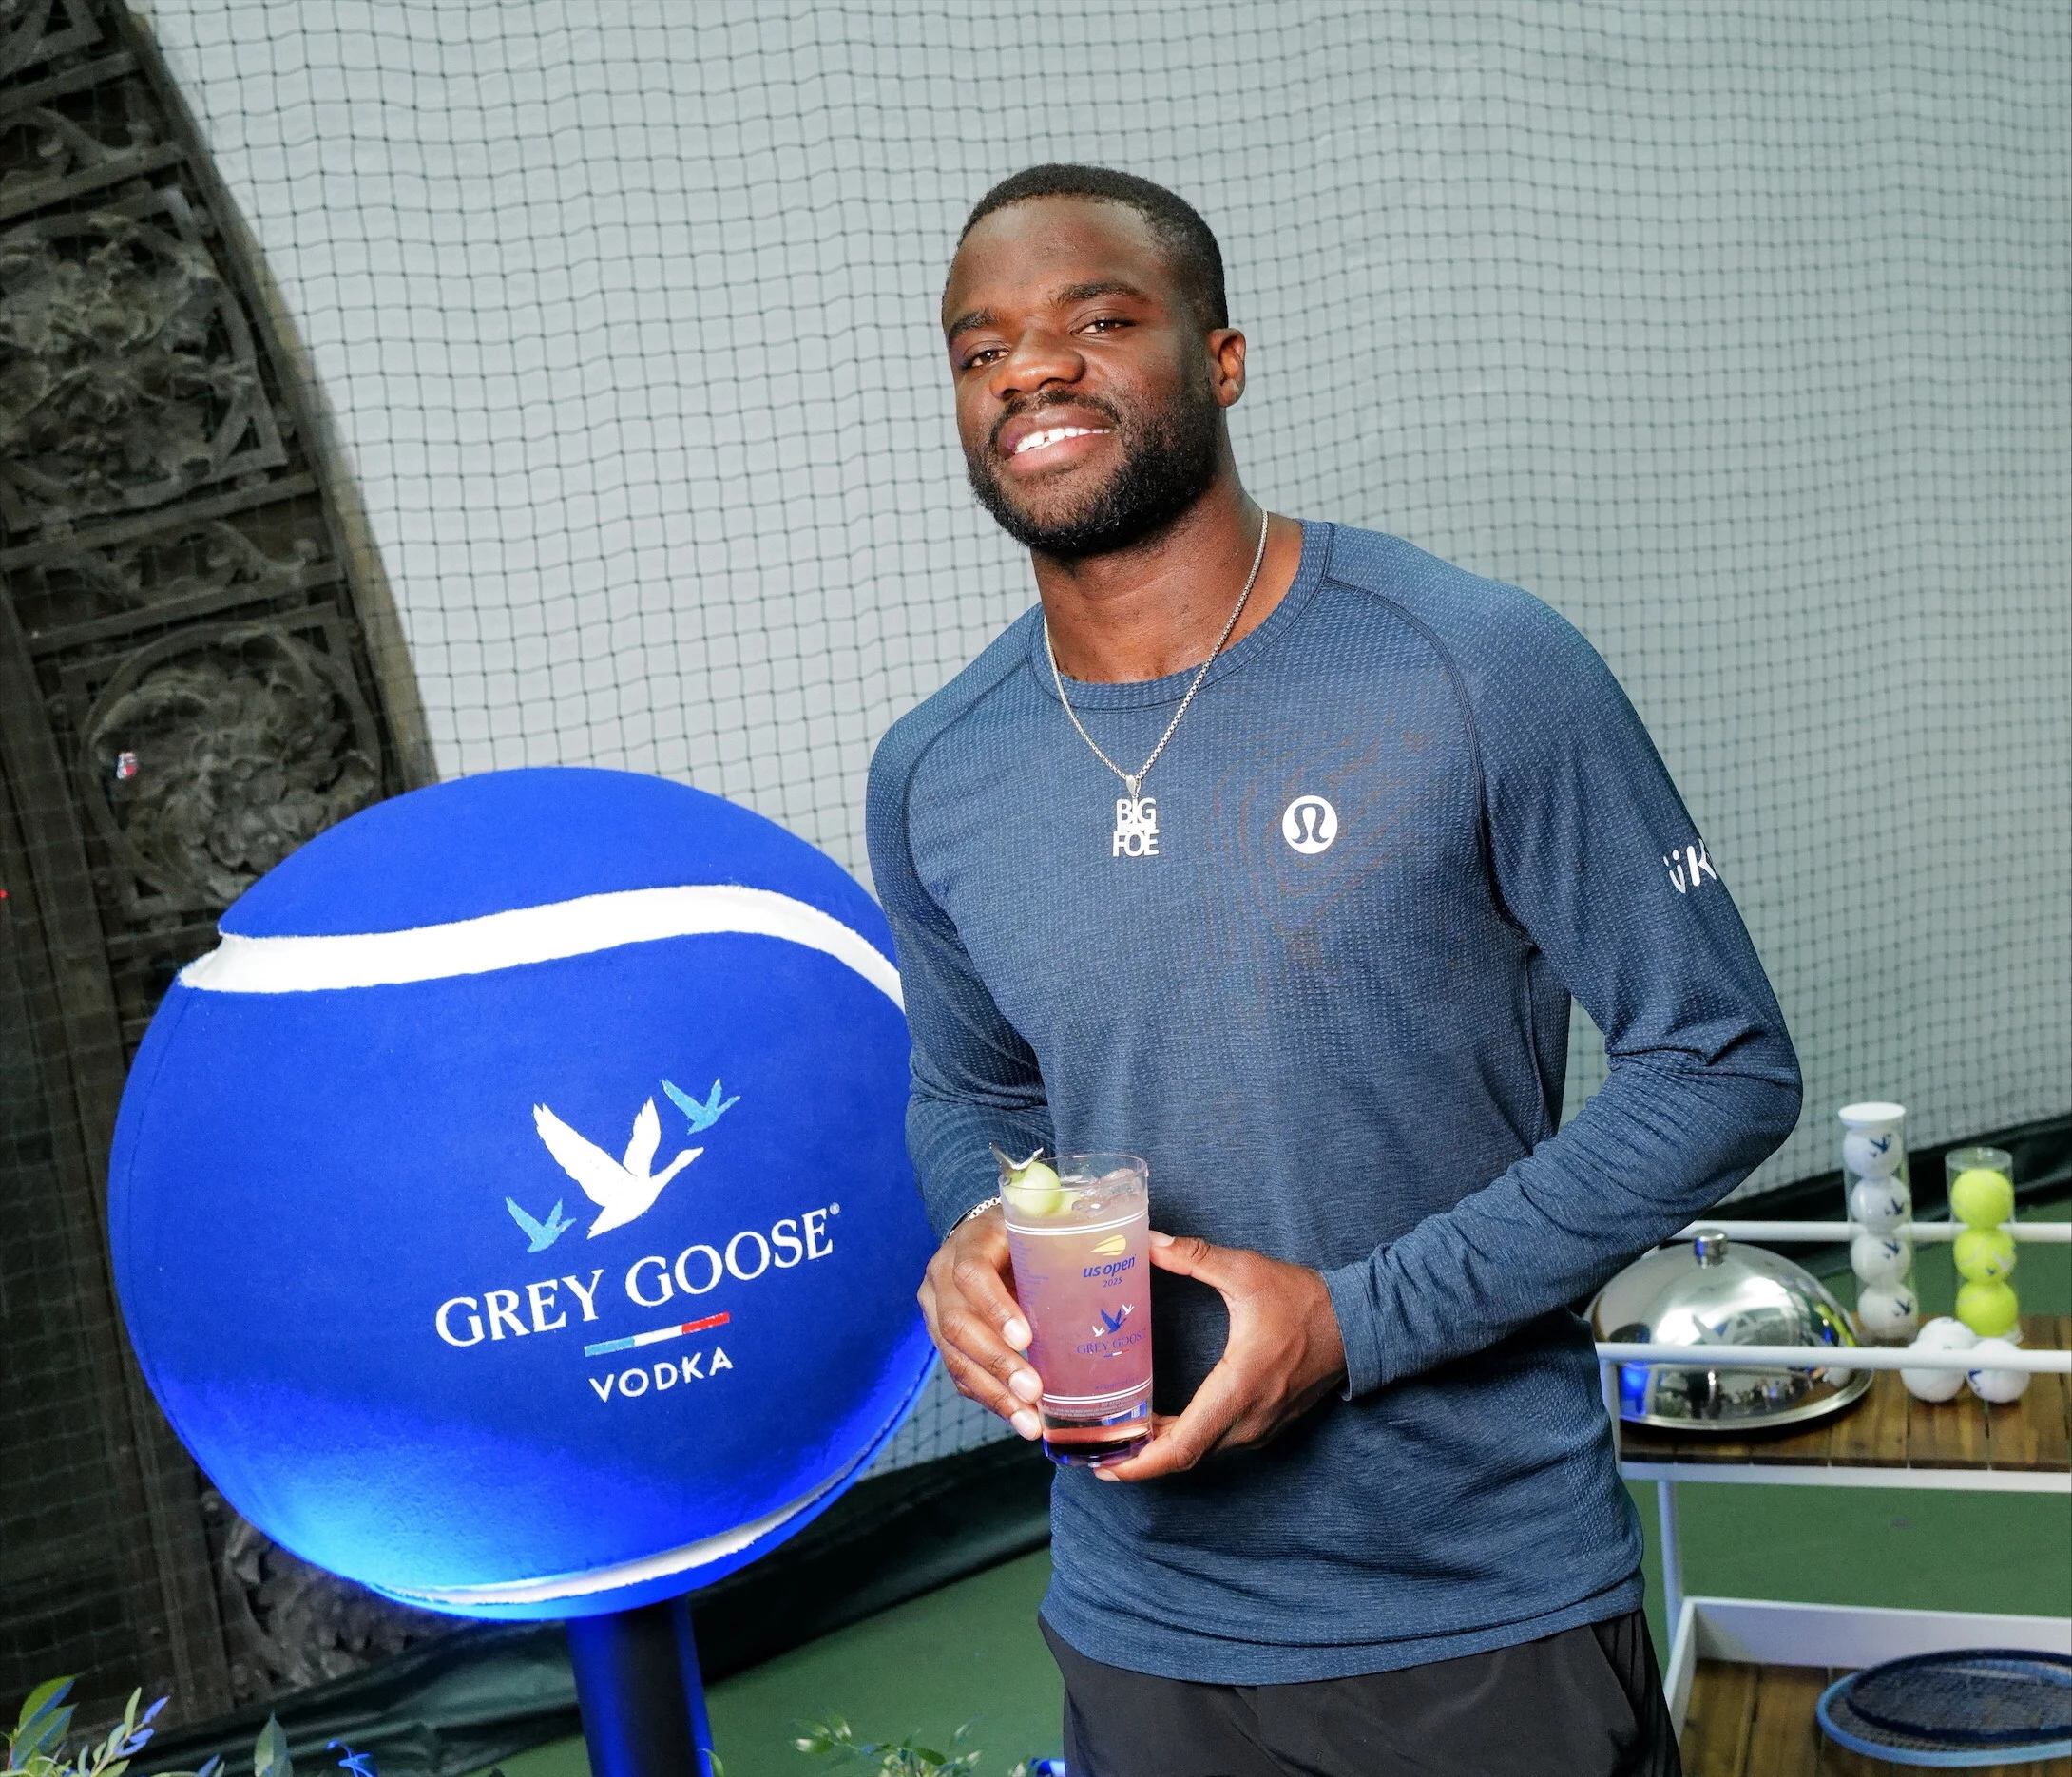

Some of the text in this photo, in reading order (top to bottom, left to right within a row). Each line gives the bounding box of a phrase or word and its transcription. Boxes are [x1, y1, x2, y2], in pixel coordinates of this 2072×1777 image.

[1116, 797, 1157, 827] BIG
[1112, 829, 1160, 857] FOE
[1083, 1256, 1135, 1278] us open
[1103, 1277, 1122, 1288] 2025
[434, 1269, 604, 1347] GREY
[1076, 1341, 1108, 1354] GREY
[588, 1346, 734, 1403] VODKA
